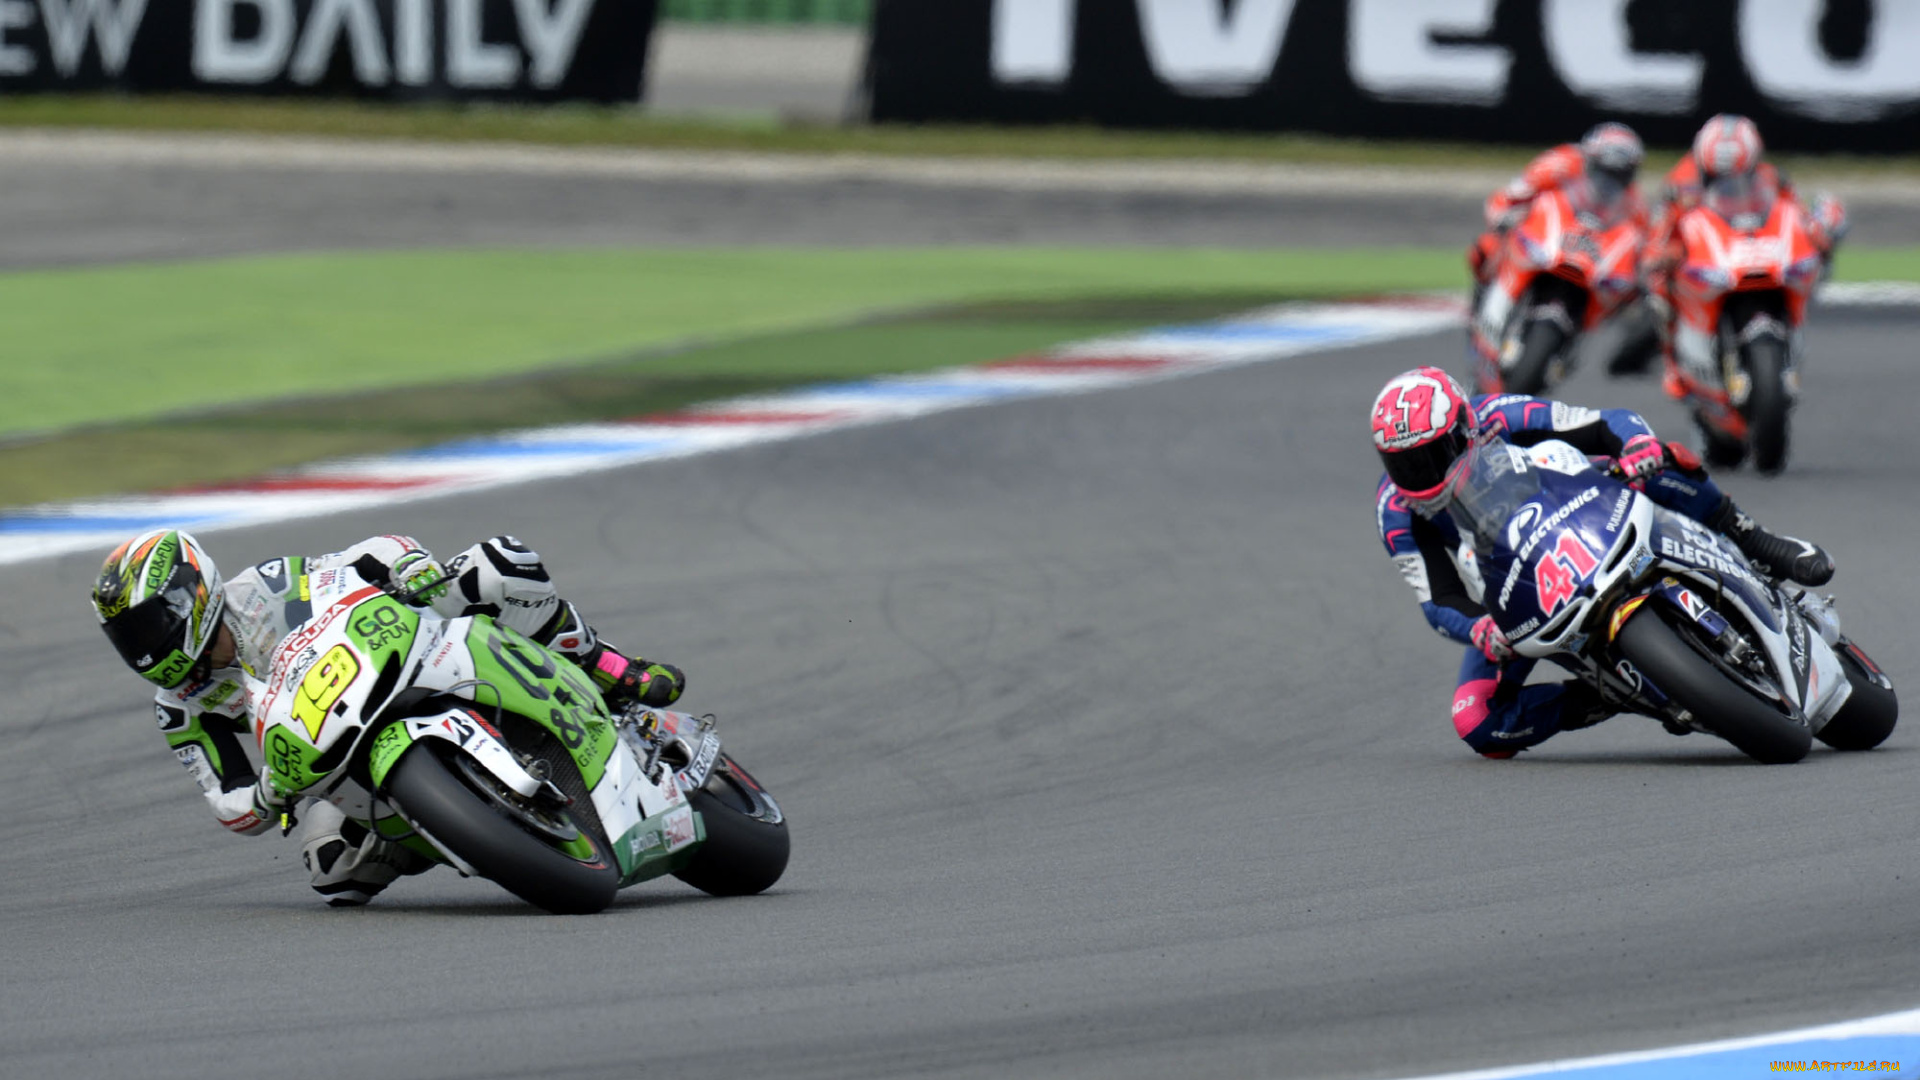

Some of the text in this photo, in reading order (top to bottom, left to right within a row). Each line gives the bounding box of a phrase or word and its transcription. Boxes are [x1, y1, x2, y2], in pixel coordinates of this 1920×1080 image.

[191, 0, 598, 89] DAILY
[990, 0, 1920, 122] IVECO
[1498, 557, 1523, 611] POWER
[1519, 485, 1600, 562] ELECTRONICS
[1534, 526, 1601, 619] 41
[257, 603, 349, 721] BARRACUDA
[354, 605, 400, 638] GO
[291, 643, 361, 745] 19
